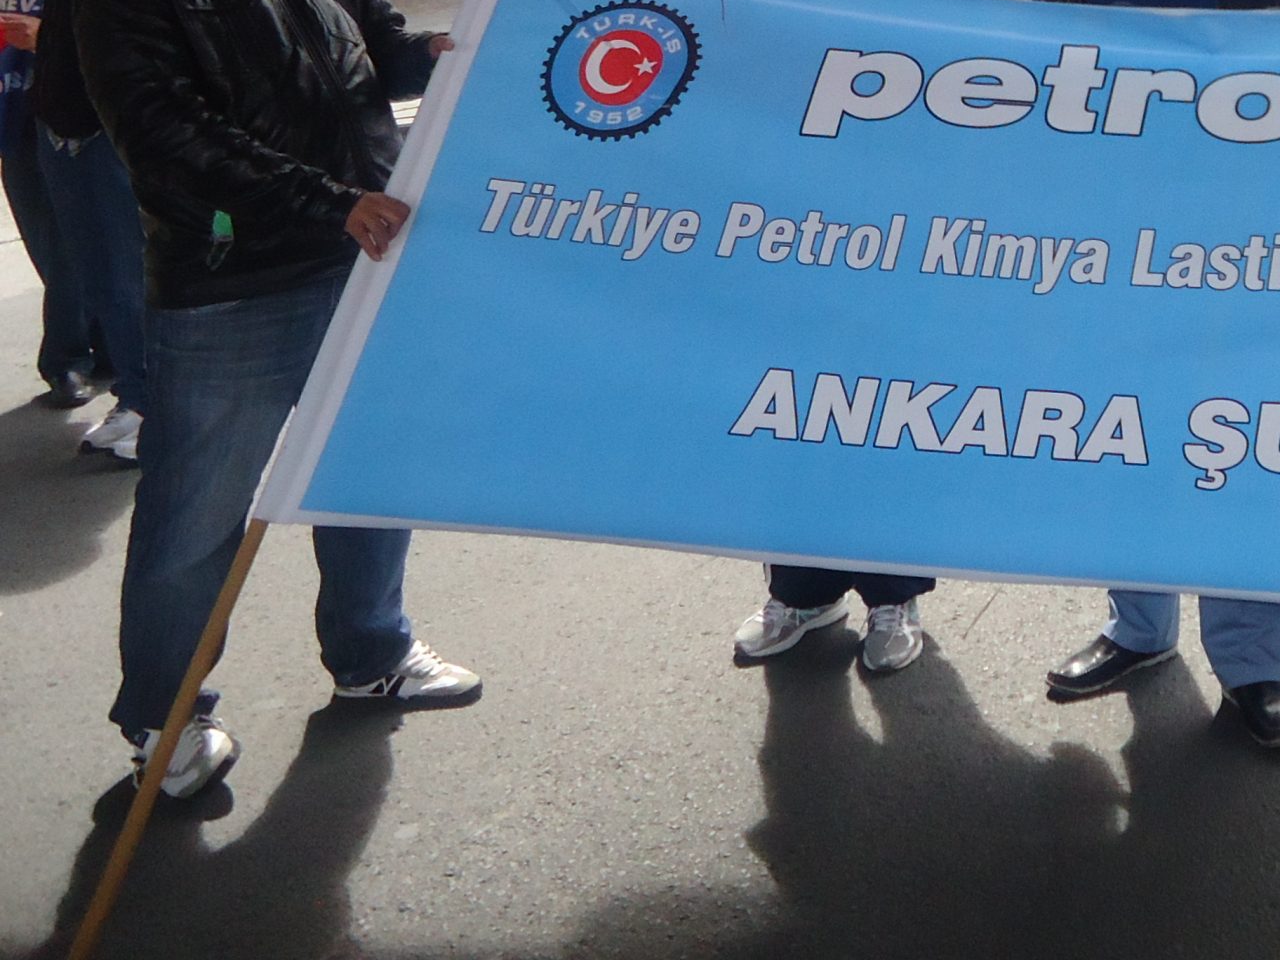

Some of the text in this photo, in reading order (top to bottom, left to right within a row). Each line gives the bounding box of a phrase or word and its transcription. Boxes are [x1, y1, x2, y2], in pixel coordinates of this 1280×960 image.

[574, 100, 643, 125] 1952
[478, 178, 700, 261] Türkiye
[715, 202, 907, 271] Petrol
[919, 216, 1111, 295] Kimya
[728, 367, 1150, 467] ANKARA
